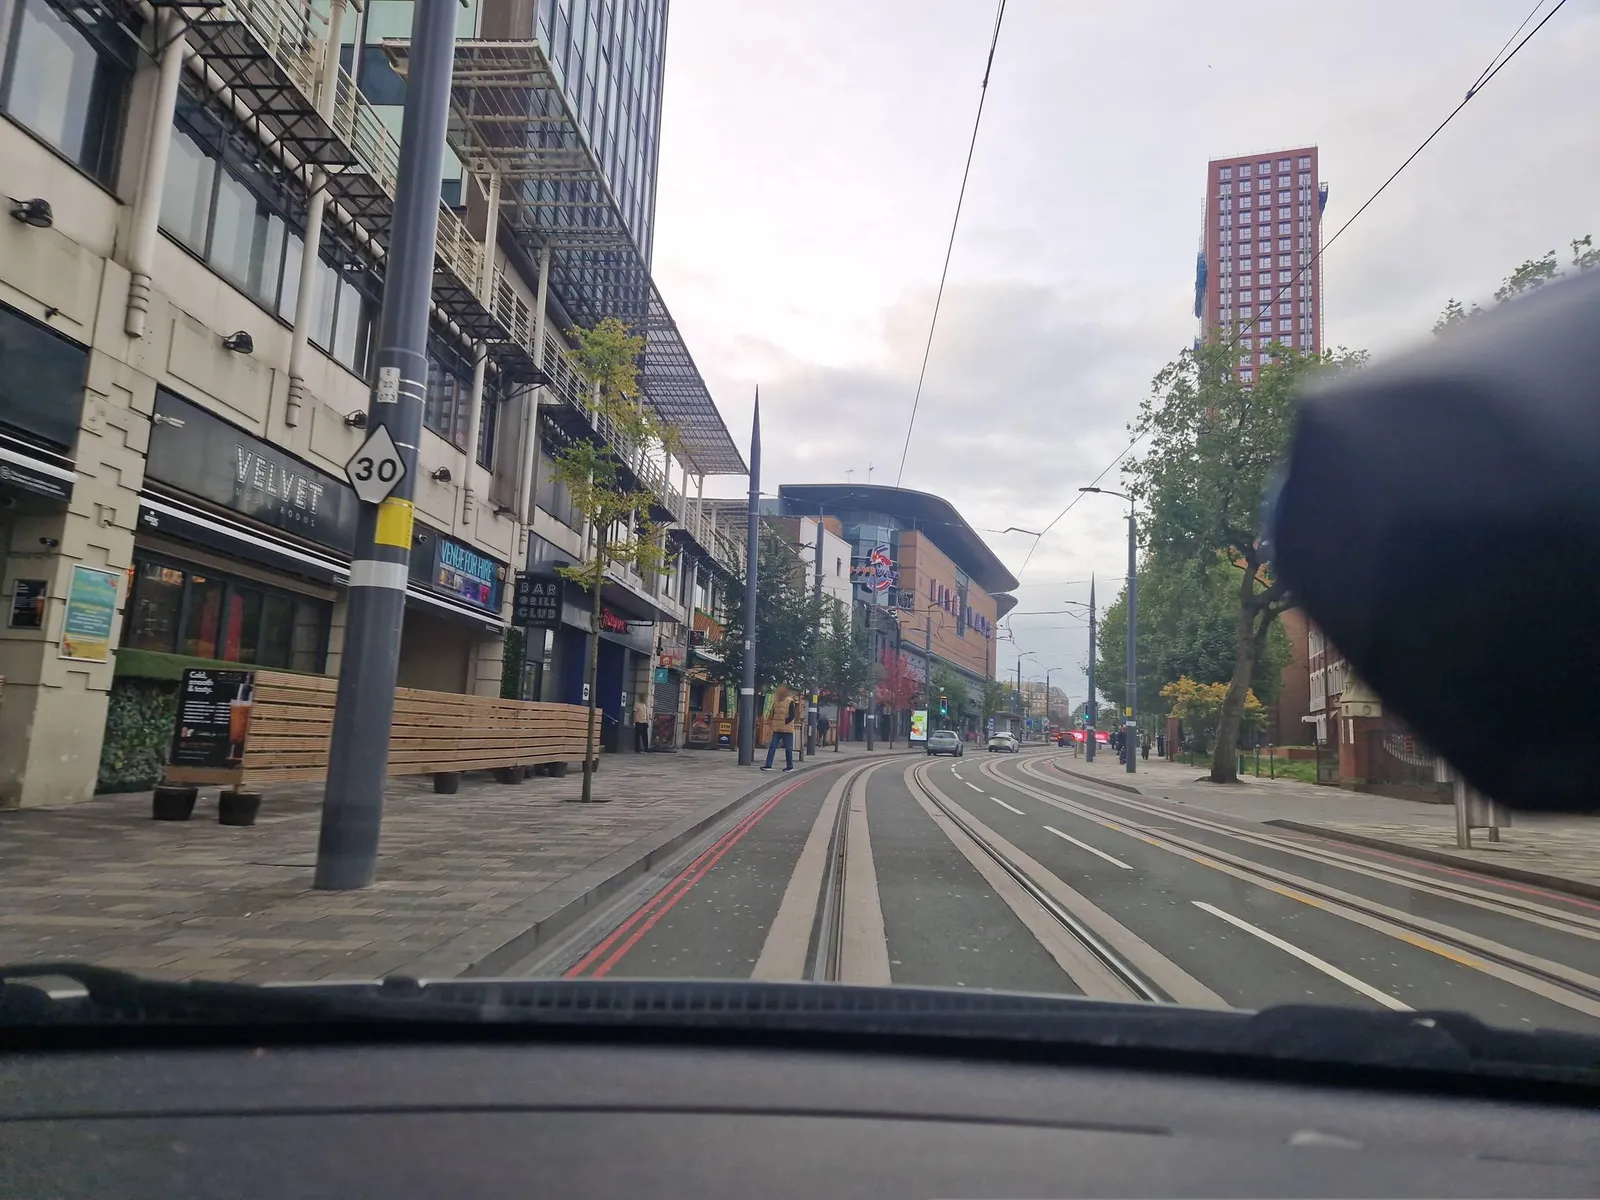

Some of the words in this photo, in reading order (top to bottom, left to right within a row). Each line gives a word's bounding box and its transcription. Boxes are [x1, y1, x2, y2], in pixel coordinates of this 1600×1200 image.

[236, 444, 324, 515] VELVET
[355, 457, 397, 482] 30
[280, 506, 315, 527] ROOMS
[441, 540, 465, 570] VENUE
[464, 550, 478, 576] FOR
[477, 558, 492, 581] HIRE
[520, 582, 557, 596] BAR
[519, 595, 557, 607] GRILL
[518, 607, 556, 620] CLUB
